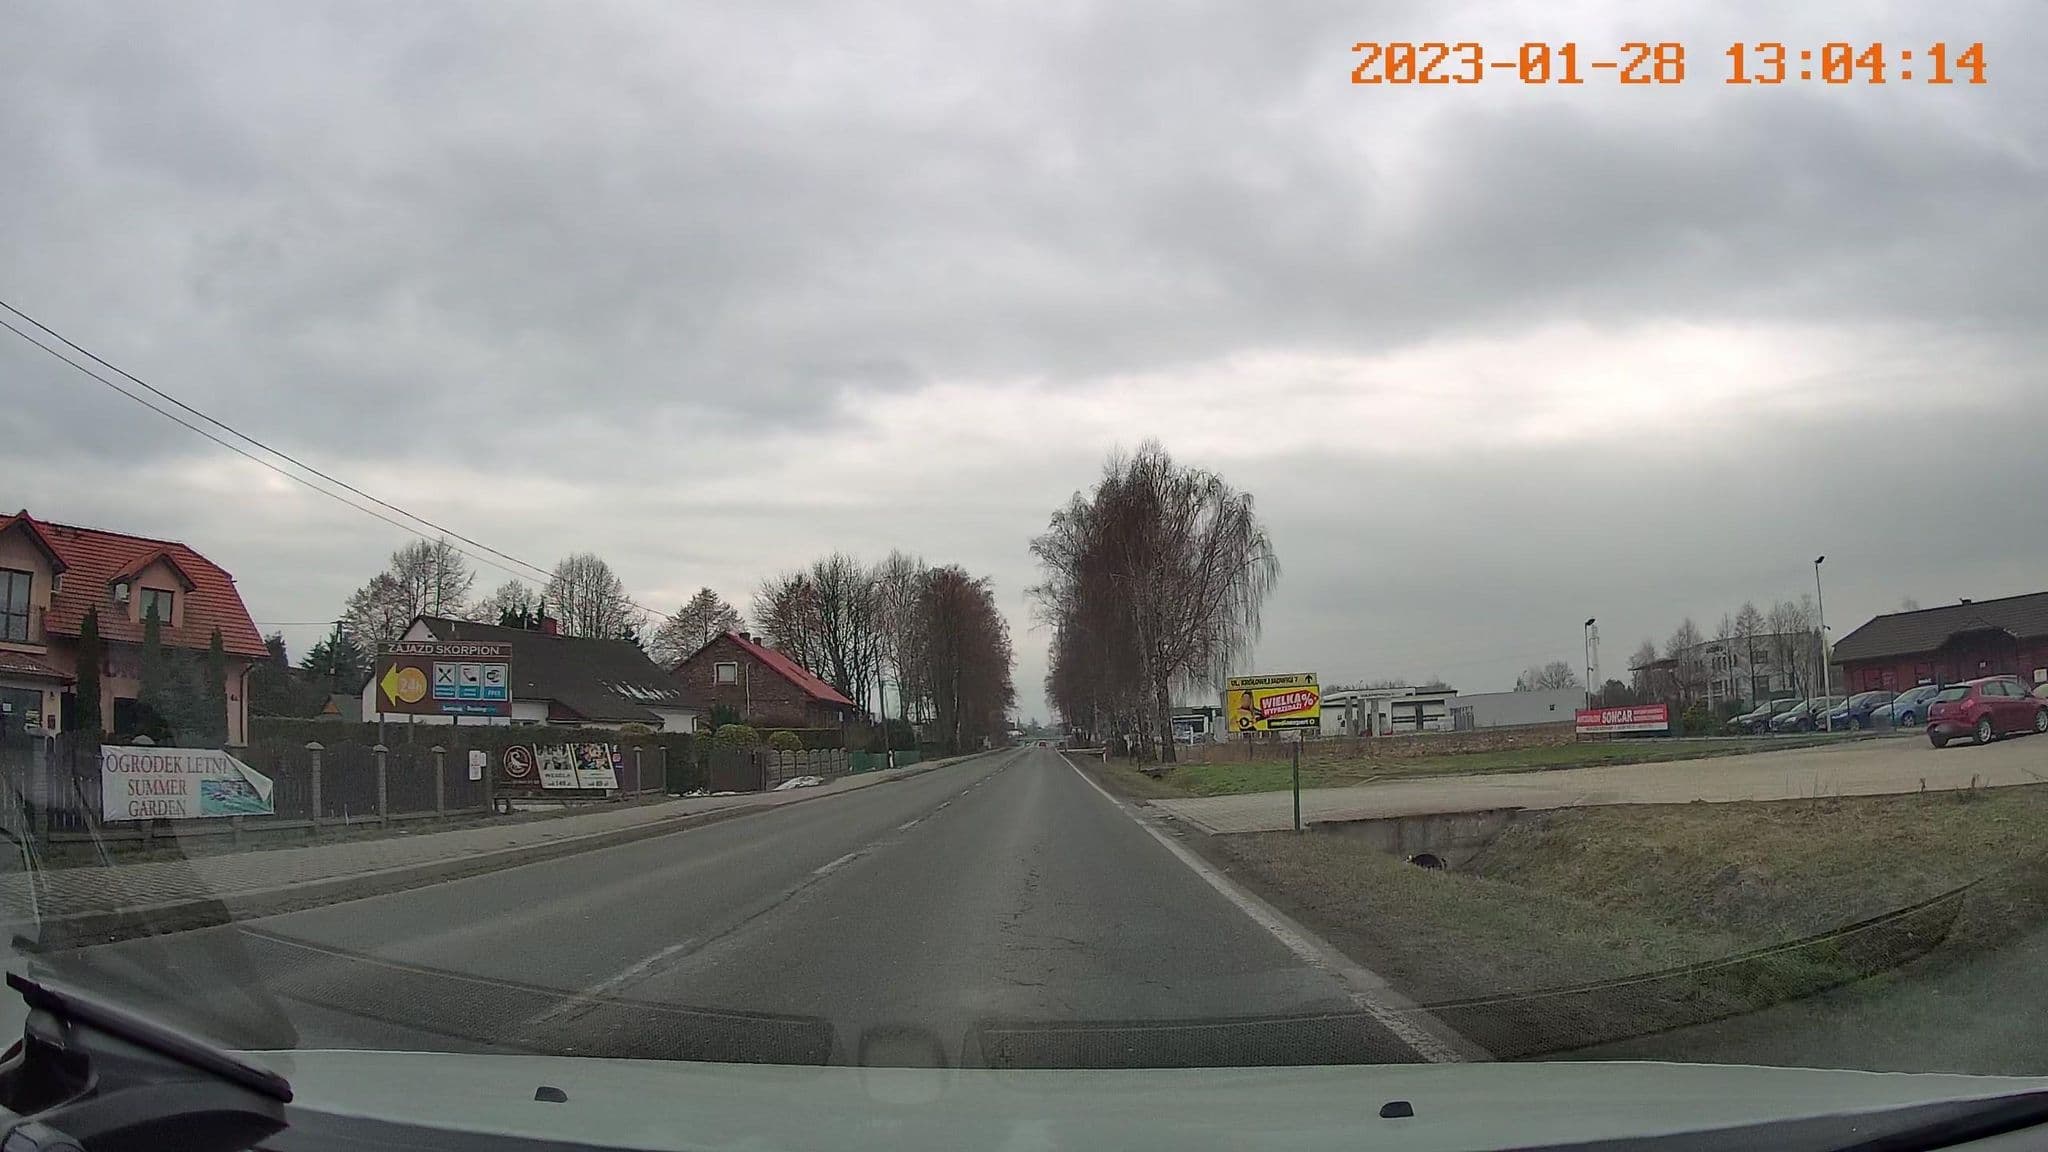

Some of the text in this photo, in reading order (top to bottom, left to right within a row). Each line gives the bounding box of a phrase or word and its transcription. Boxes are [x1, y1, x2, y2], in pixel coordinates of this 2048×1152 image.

[388, 644, 500, 655] ZAJAZD SKORPION
[1262, 693, 1301, 709] WIELKA
[187, 756, 227, 774] LETNI
[128, 779, 188, 796] SUMMER
[128, 799, 186, 817] GARDEN
